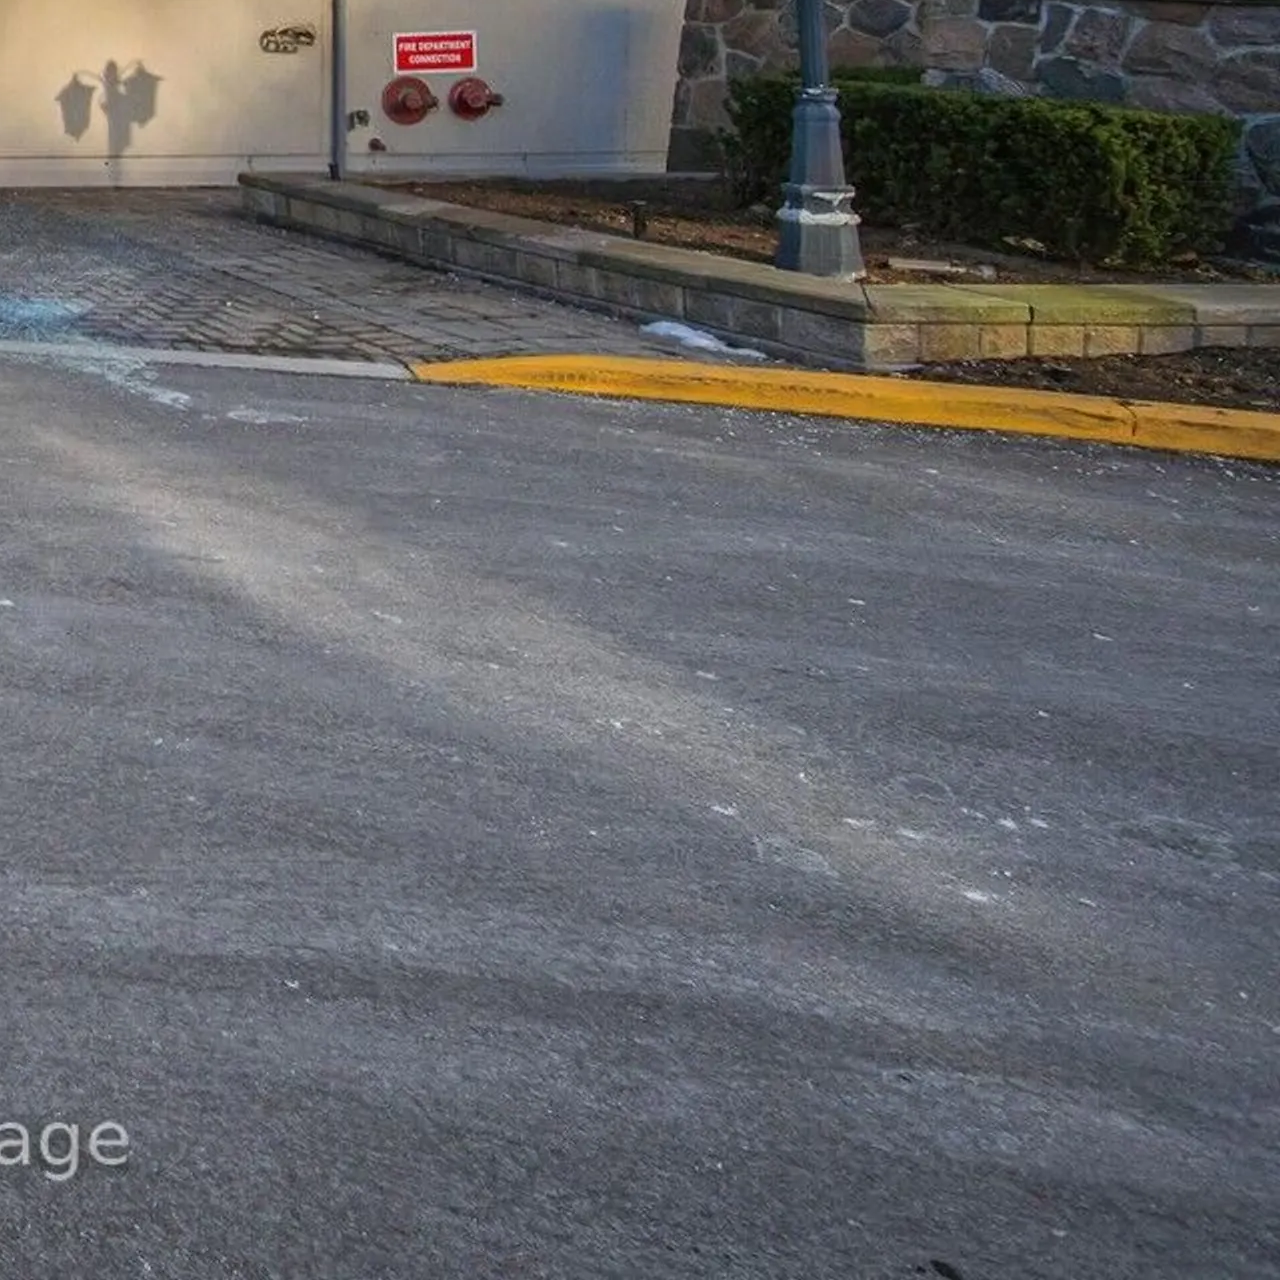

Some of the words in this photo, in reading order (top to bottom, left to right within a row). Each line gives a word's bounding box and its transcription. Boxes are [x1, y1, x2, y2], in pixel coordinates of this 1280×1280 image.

[398, 42, 417, 52] FIRE
[418, 40, 471, 51] DEPARTMENT
[408, 53, 461, 64] CONNECTION
